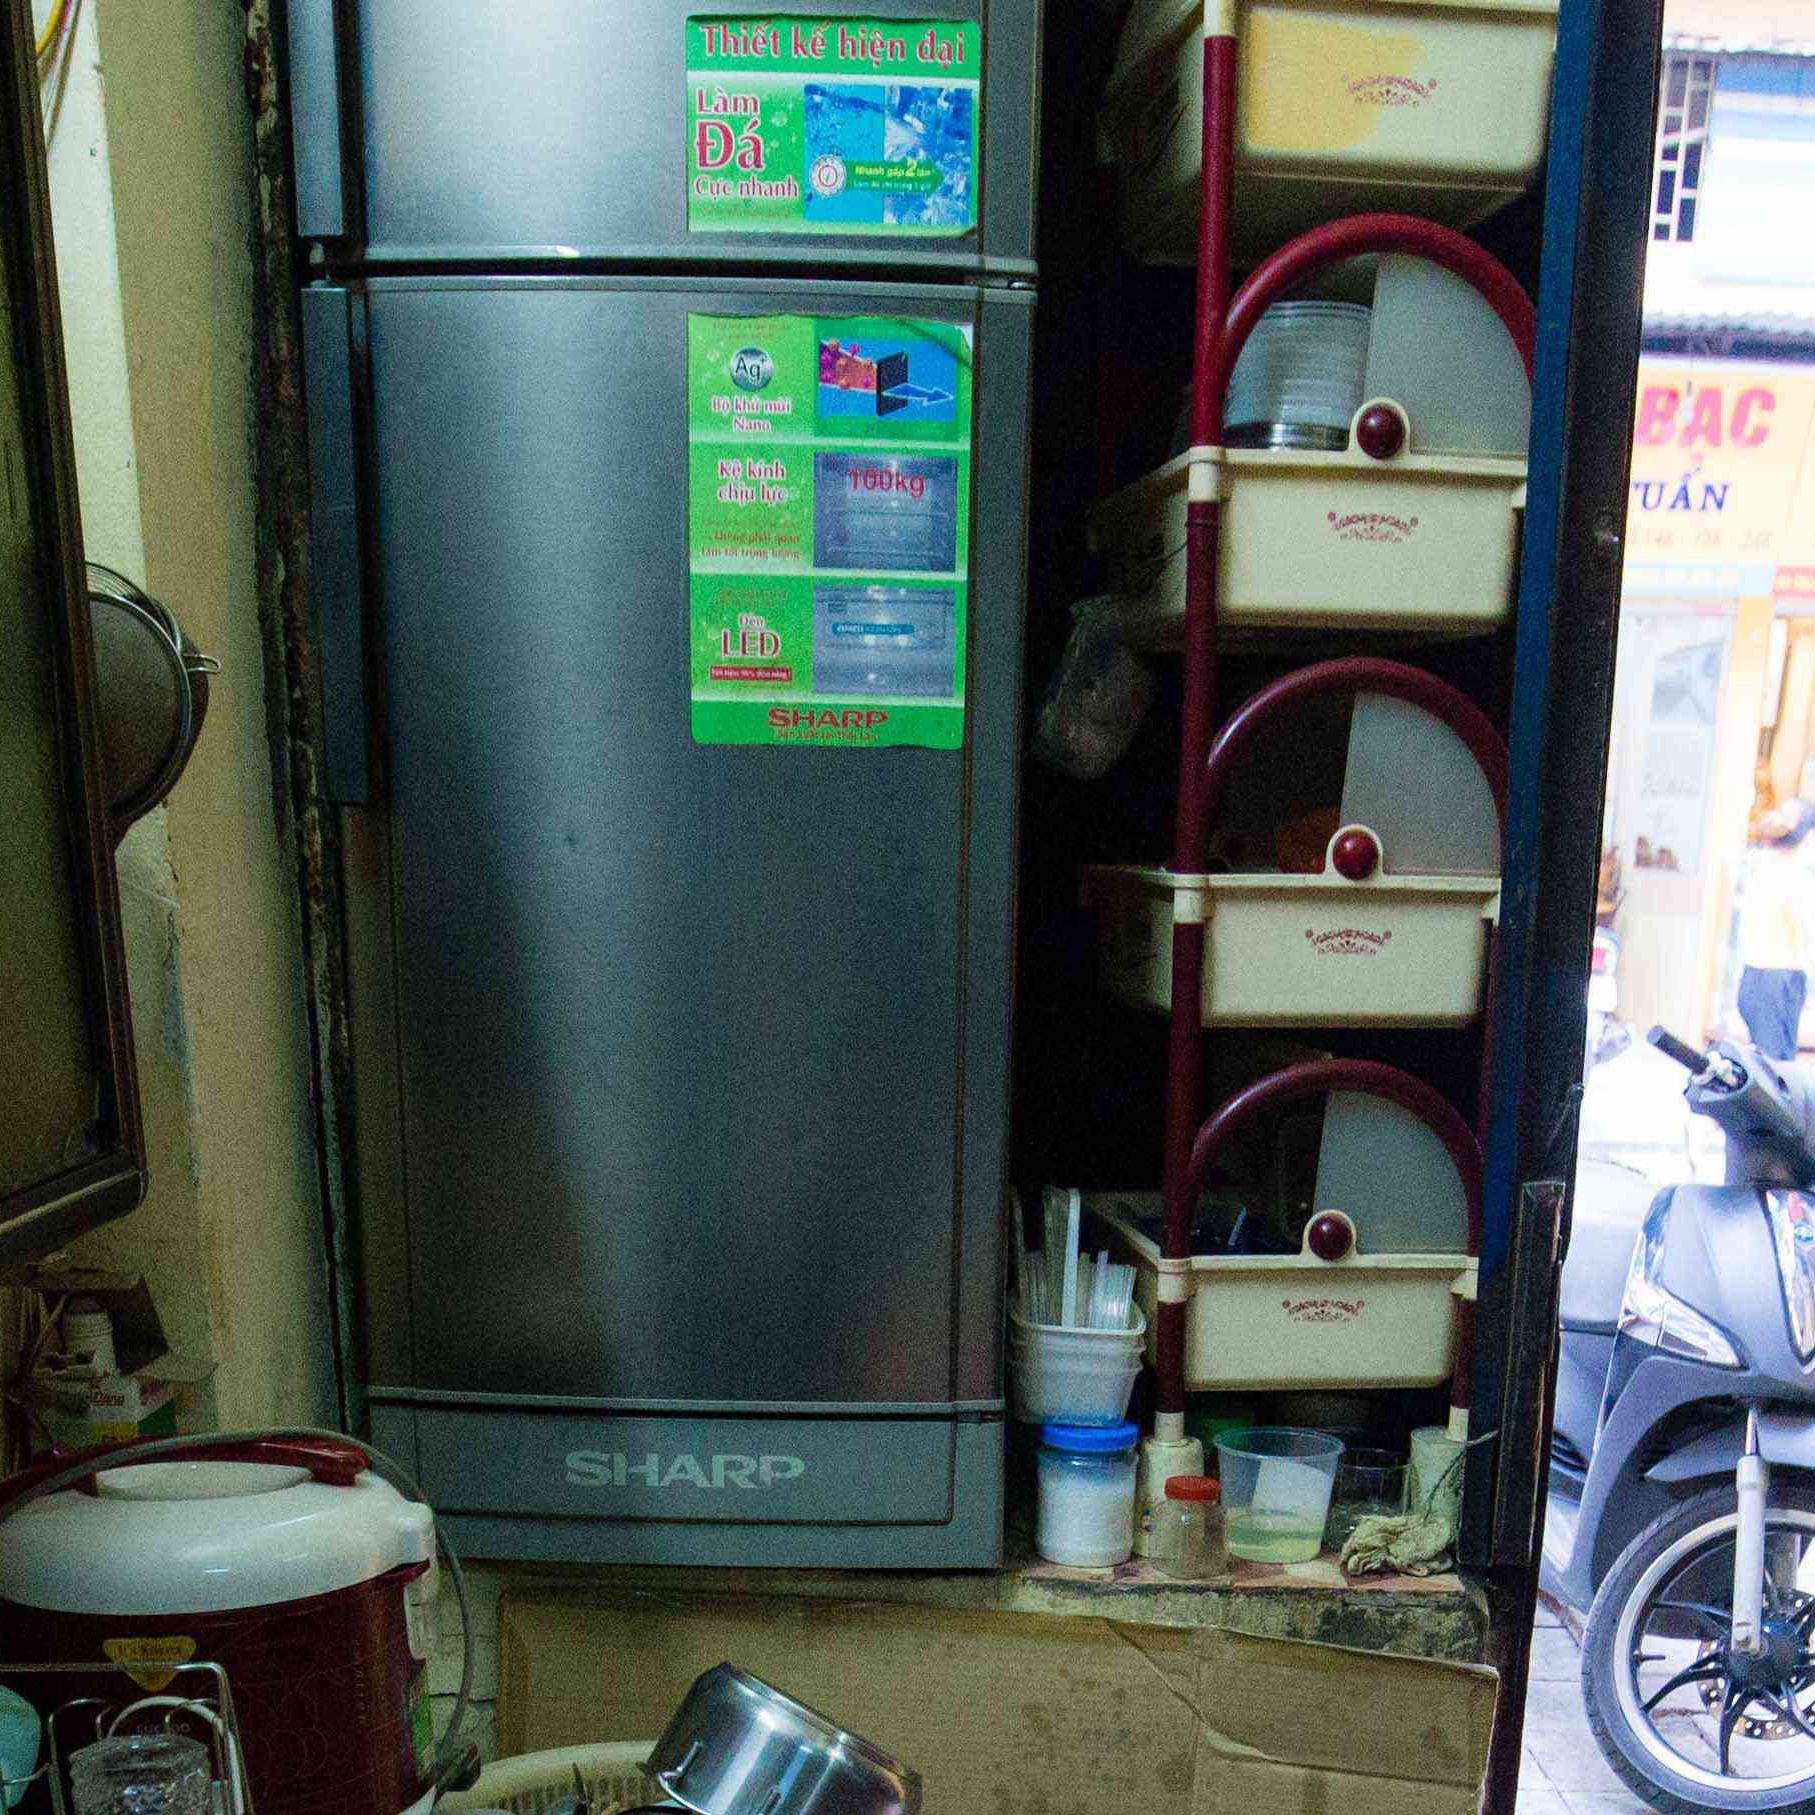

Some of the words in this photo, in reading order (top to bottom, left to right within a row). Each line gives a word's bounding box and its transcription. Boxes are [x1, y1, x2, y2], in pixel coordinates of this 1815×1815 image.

[699, 20, 780, 58] Thiết
[791, 19, 832, 60] kế
[838, 25, 906, 67] hiện
[916, 29, 965, 70] đại
[695, 86, 759, 114] Làm
[695, 118, 764, 170] Đá
[904, 158, 918, 177] 2
[694, 174, 731, 200] Cực
[737, 174, 799, 198] nhanh
[733, 417, 771, 431] Nano
[1633, 384, 1778, 466] BẠC
[717, 459, 742, 482] Kệ
[746, 458, 787, 481] kính
[847, 465, 926, 500] 100kg
[717, 484, 755, 507] chịu
[759, 484, 788, 507] lực
[721, 629, 780, 657] LED
[767, 706, 889, 729] SHARP
[565, 1449, 806, 1490] SHARP
